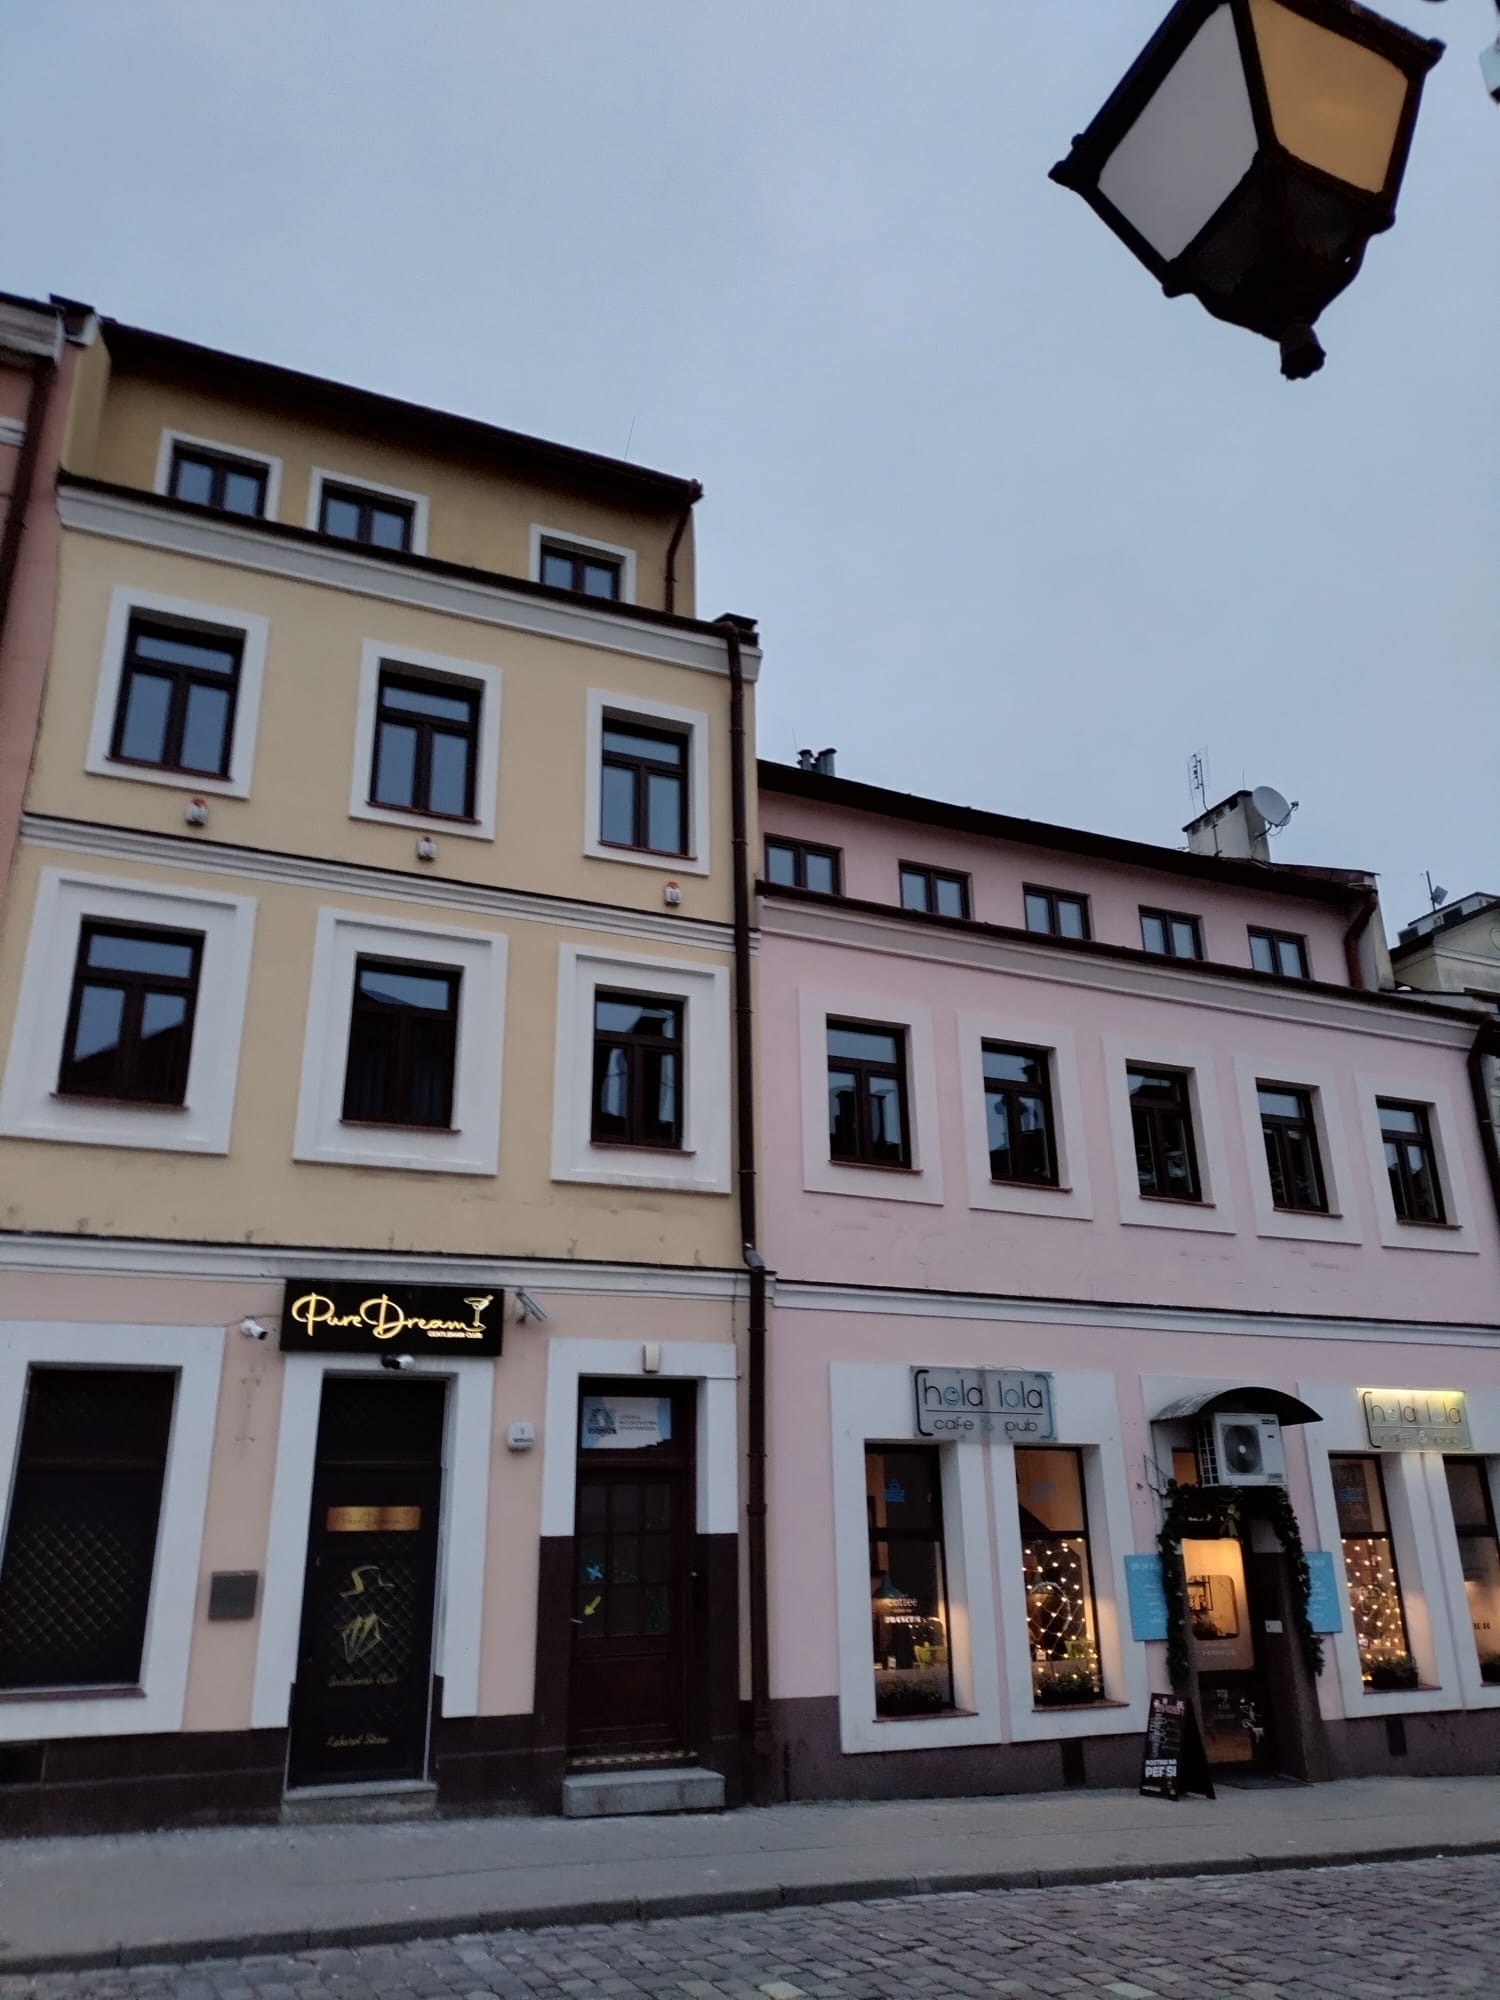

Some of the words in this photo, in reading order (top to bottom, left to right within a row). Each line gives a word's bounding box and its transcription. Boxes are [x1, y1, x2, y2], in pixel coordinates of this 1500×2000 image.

[291, 1292, 363, 1336] Pure
[360, 1294, 486, 1339] Dream
[998, 1380, 1043, 1409] lola
[934, 1416, 975, 1431] cafe
[1005, 1418, 1038, 1435] pub
